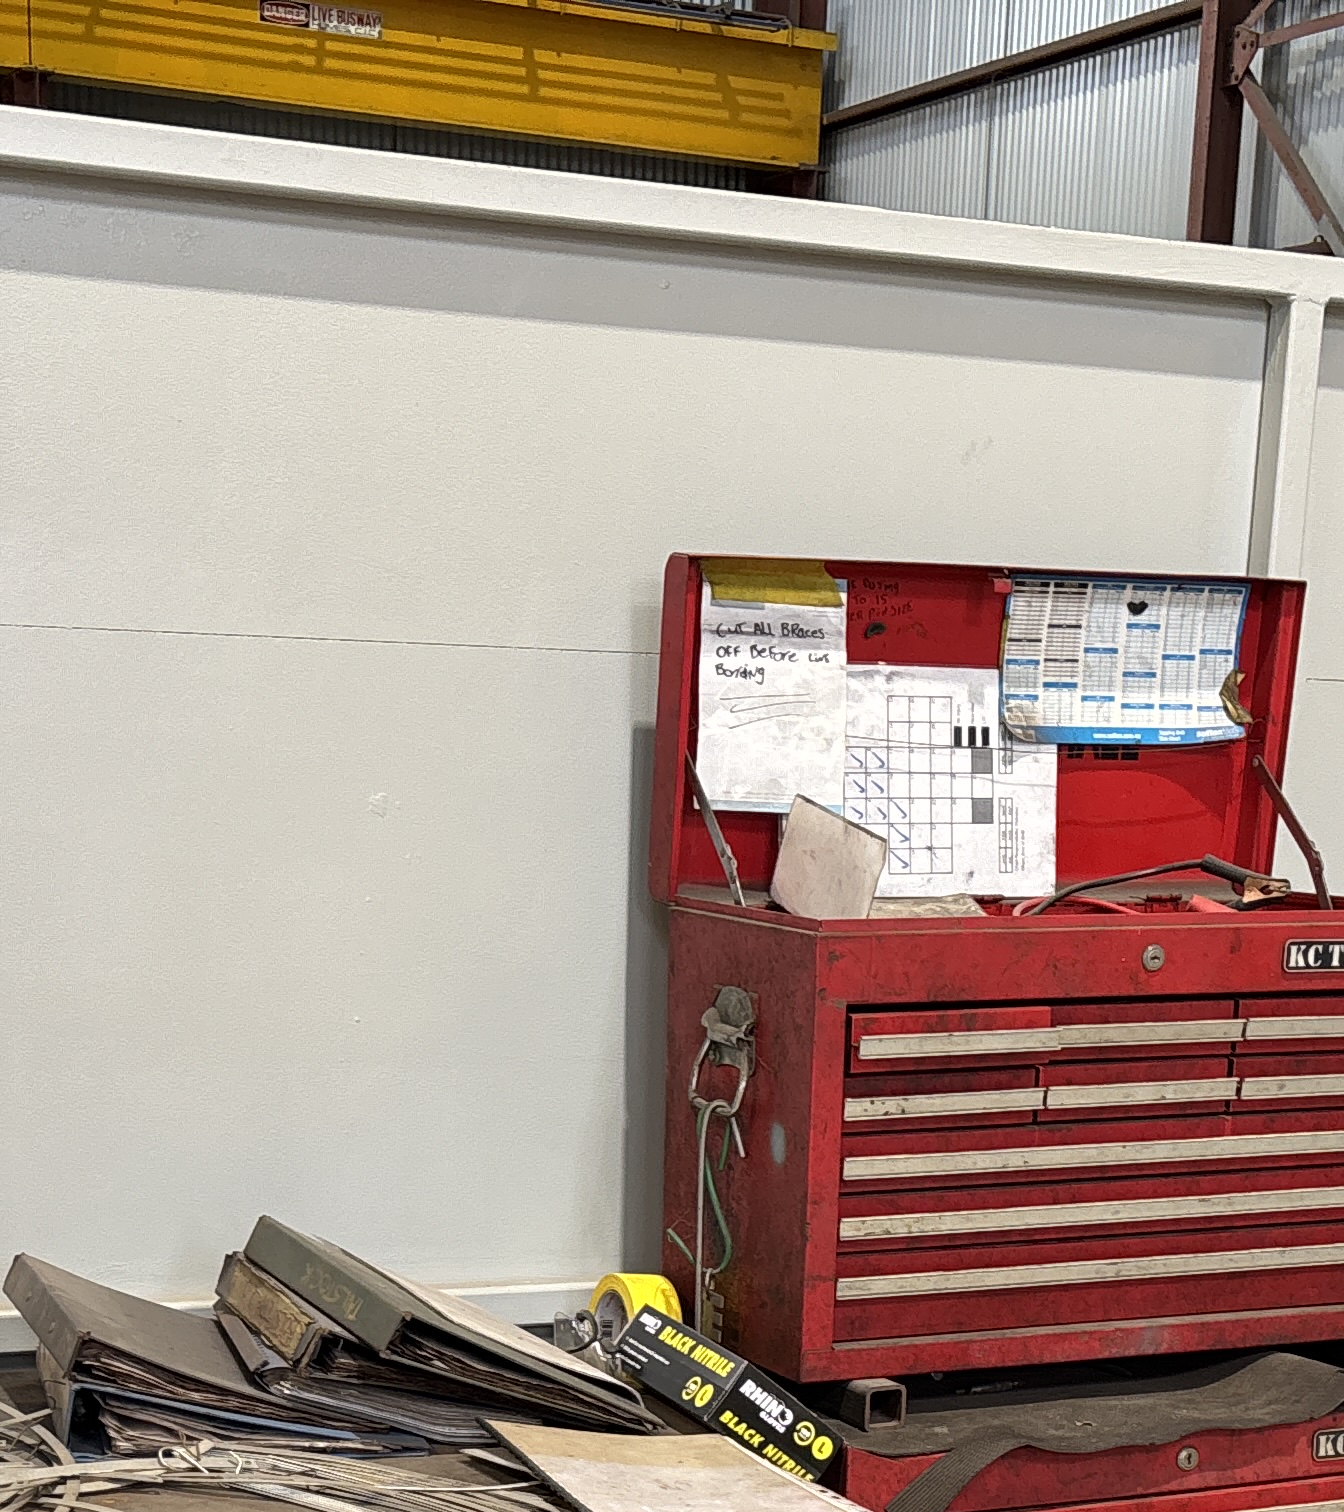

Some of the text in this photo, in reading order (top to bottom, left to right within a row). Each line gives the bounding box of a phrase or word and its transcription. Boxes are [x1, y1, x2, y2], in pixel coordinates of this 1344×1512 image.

[264, 4, 306, 20] DANGER
[311, 5, 382, 28] LIVE BUSWAY
[1288, 944, 1324, 967] KC
[658, 1325, 696, 1355] BLACK
[690, 1344, 735, 1377] NITRILE
[739, 1379, 794, 1426] RHINO
[719, 1410, 765, 1448] BLACK
